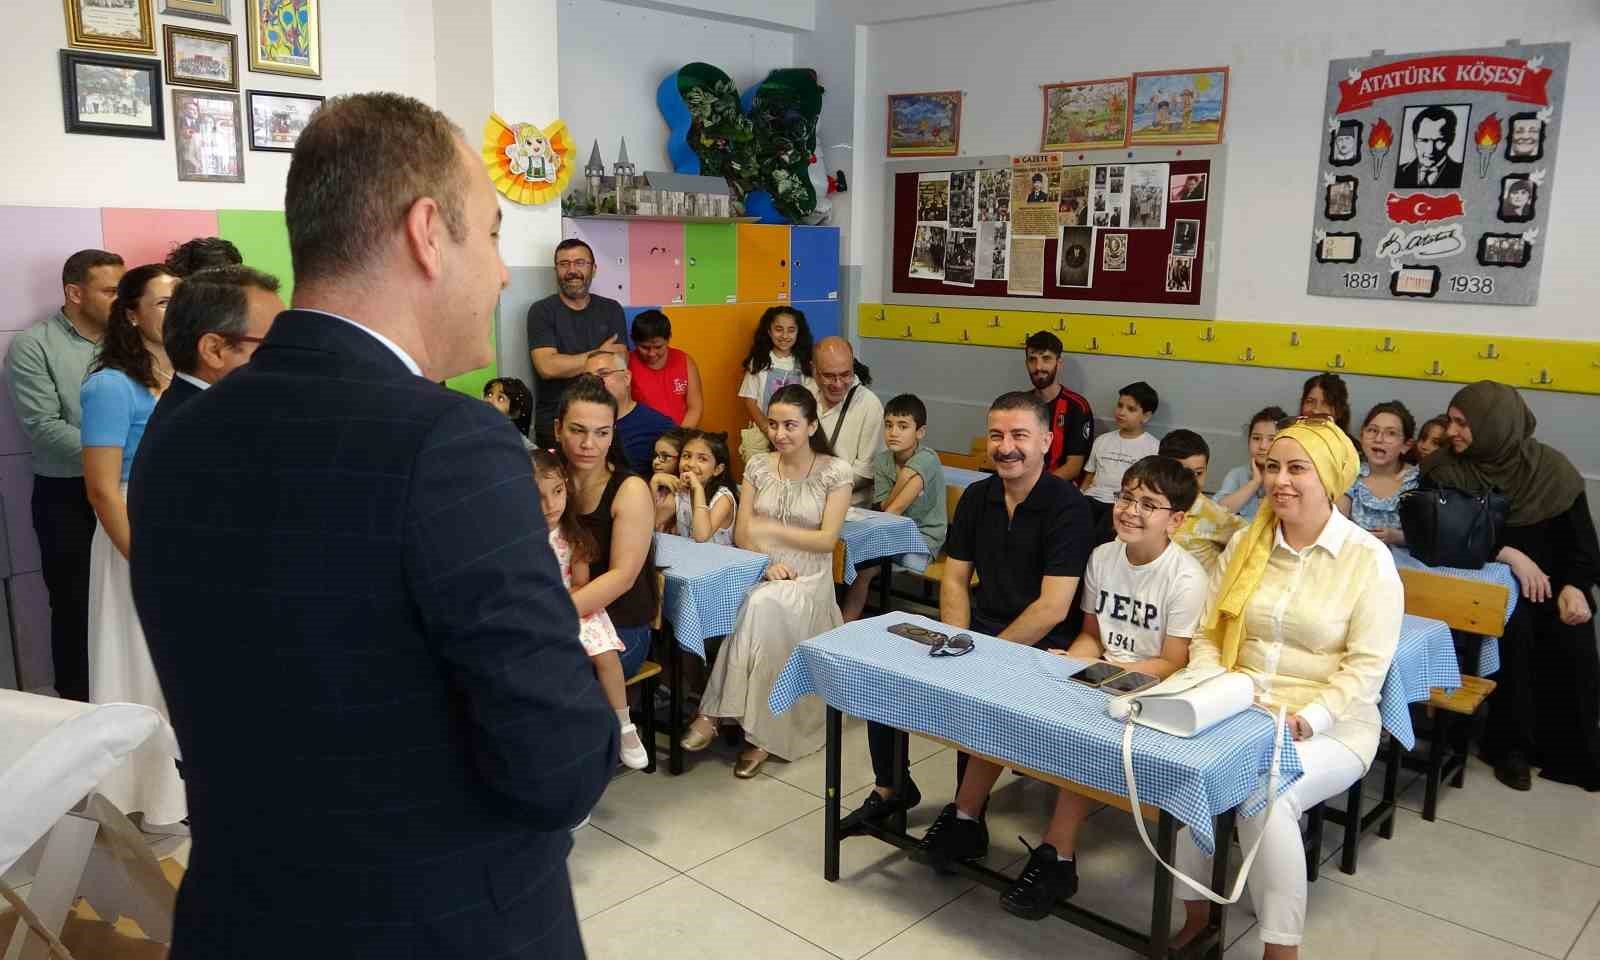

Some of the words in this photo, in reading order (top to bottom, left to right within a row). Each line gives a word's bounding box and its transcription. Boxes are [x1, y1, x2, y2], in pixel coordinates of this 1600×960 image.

[1359, 66, 1446, 95] ATATÜRK
[1455, 61, 1527, 87] KÖŞESİ
[1343, 273, 1379, 289] 1881
[1450, 276, 1493, 294] 1938
[1107, 631, 1135, 652] 1941
